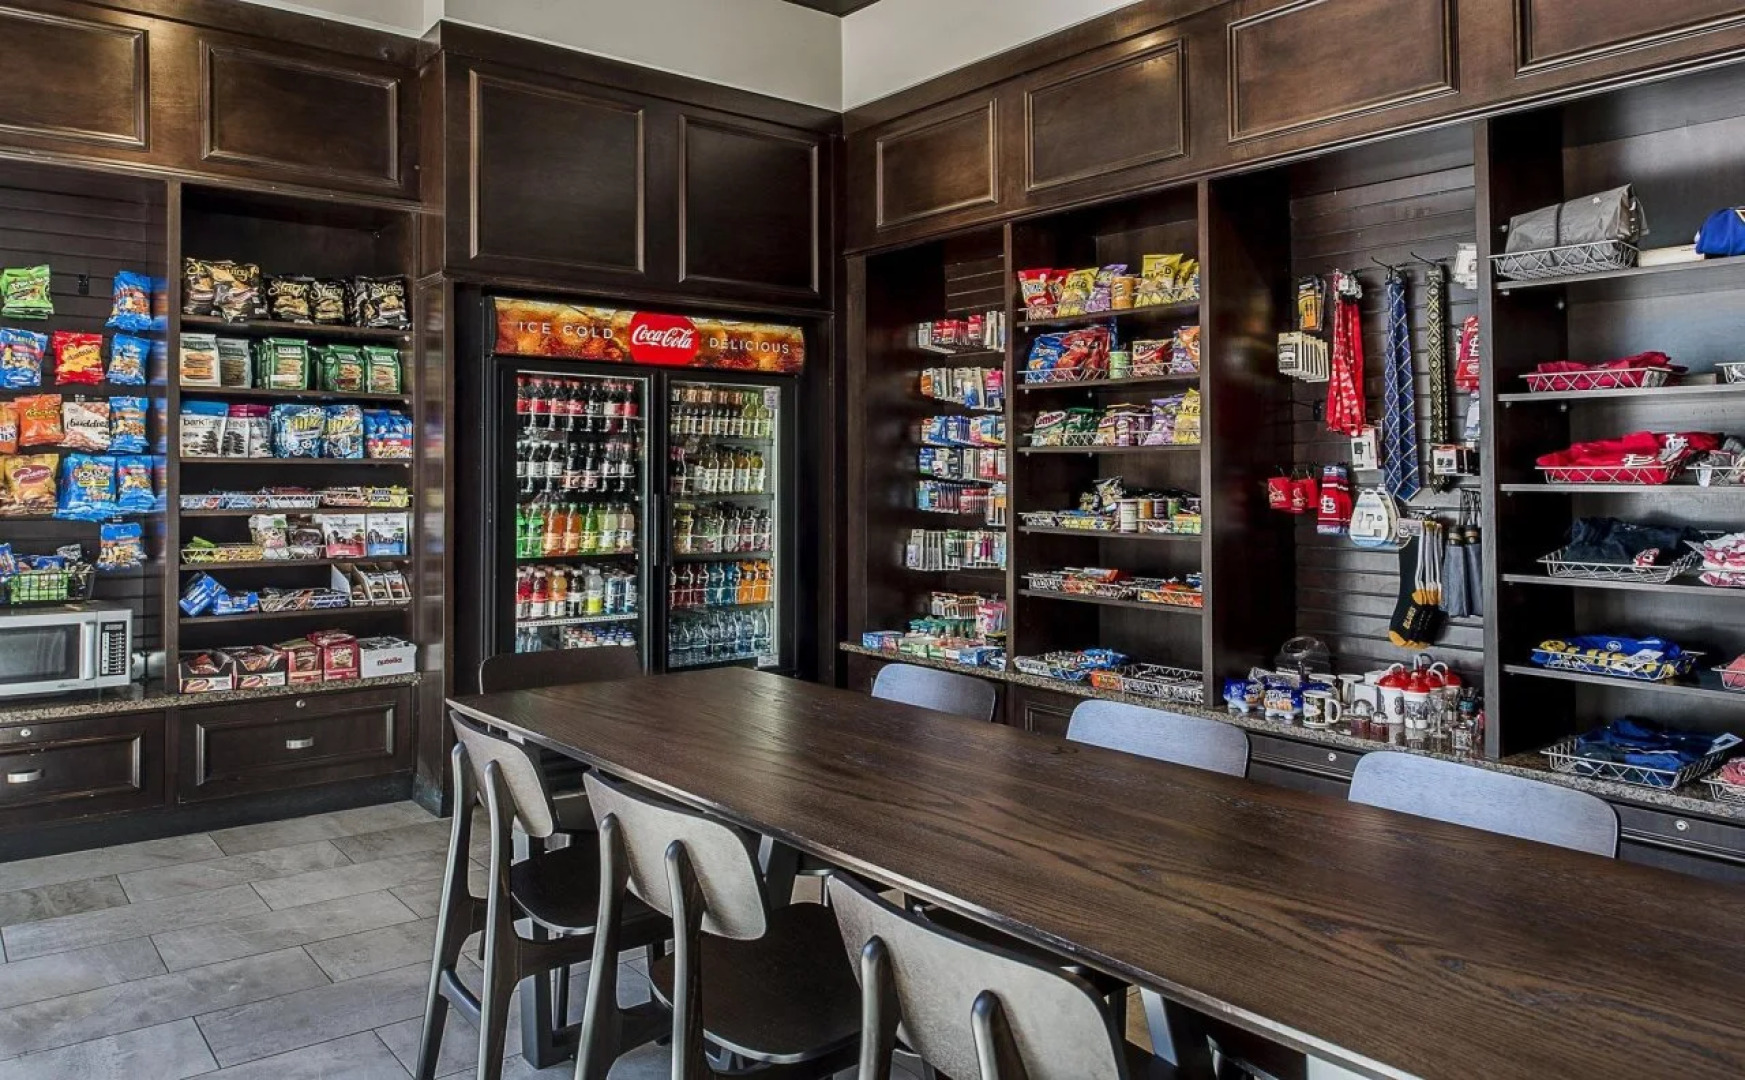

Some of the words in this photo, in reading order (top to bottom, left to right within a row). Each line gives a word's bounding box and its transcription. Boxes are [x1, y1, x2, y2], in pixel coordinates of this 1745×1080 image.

[519, 321, 552, 335] ICE
[562, 325, 614, 339] COLD
[631, 324, 695, 349] Coca-Cola
[709, 337, 789, 354] DELICIOUS
